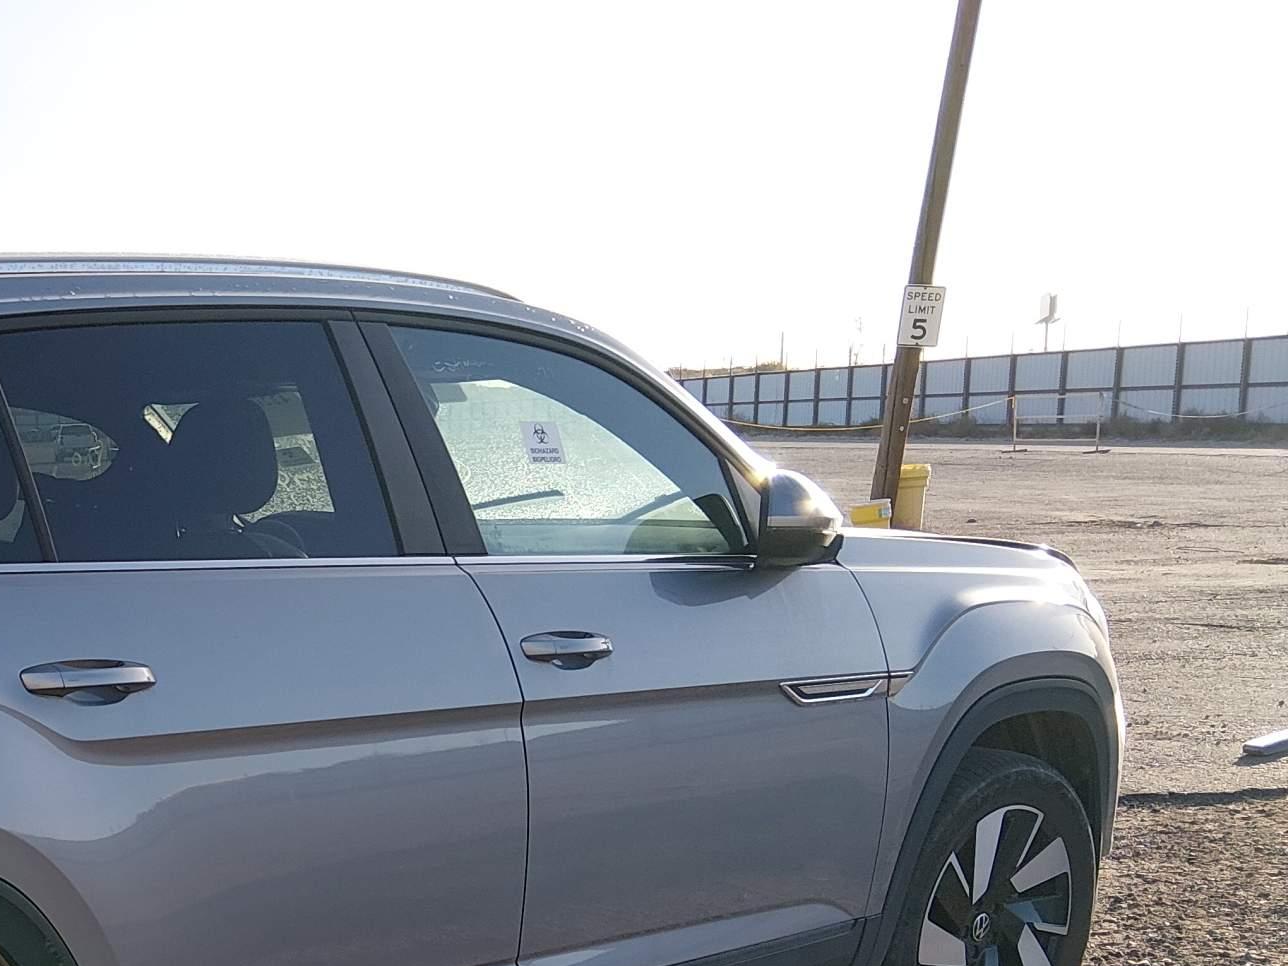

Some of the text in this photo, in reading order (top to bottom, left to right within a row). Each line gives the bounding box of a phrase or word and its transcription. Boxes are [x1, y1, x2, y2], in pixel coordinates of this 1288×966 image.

[907, 291, 941, 301] SPEED
[908, 305, 936, 314] LIMIT
[910, 318, 927, 340] 5
